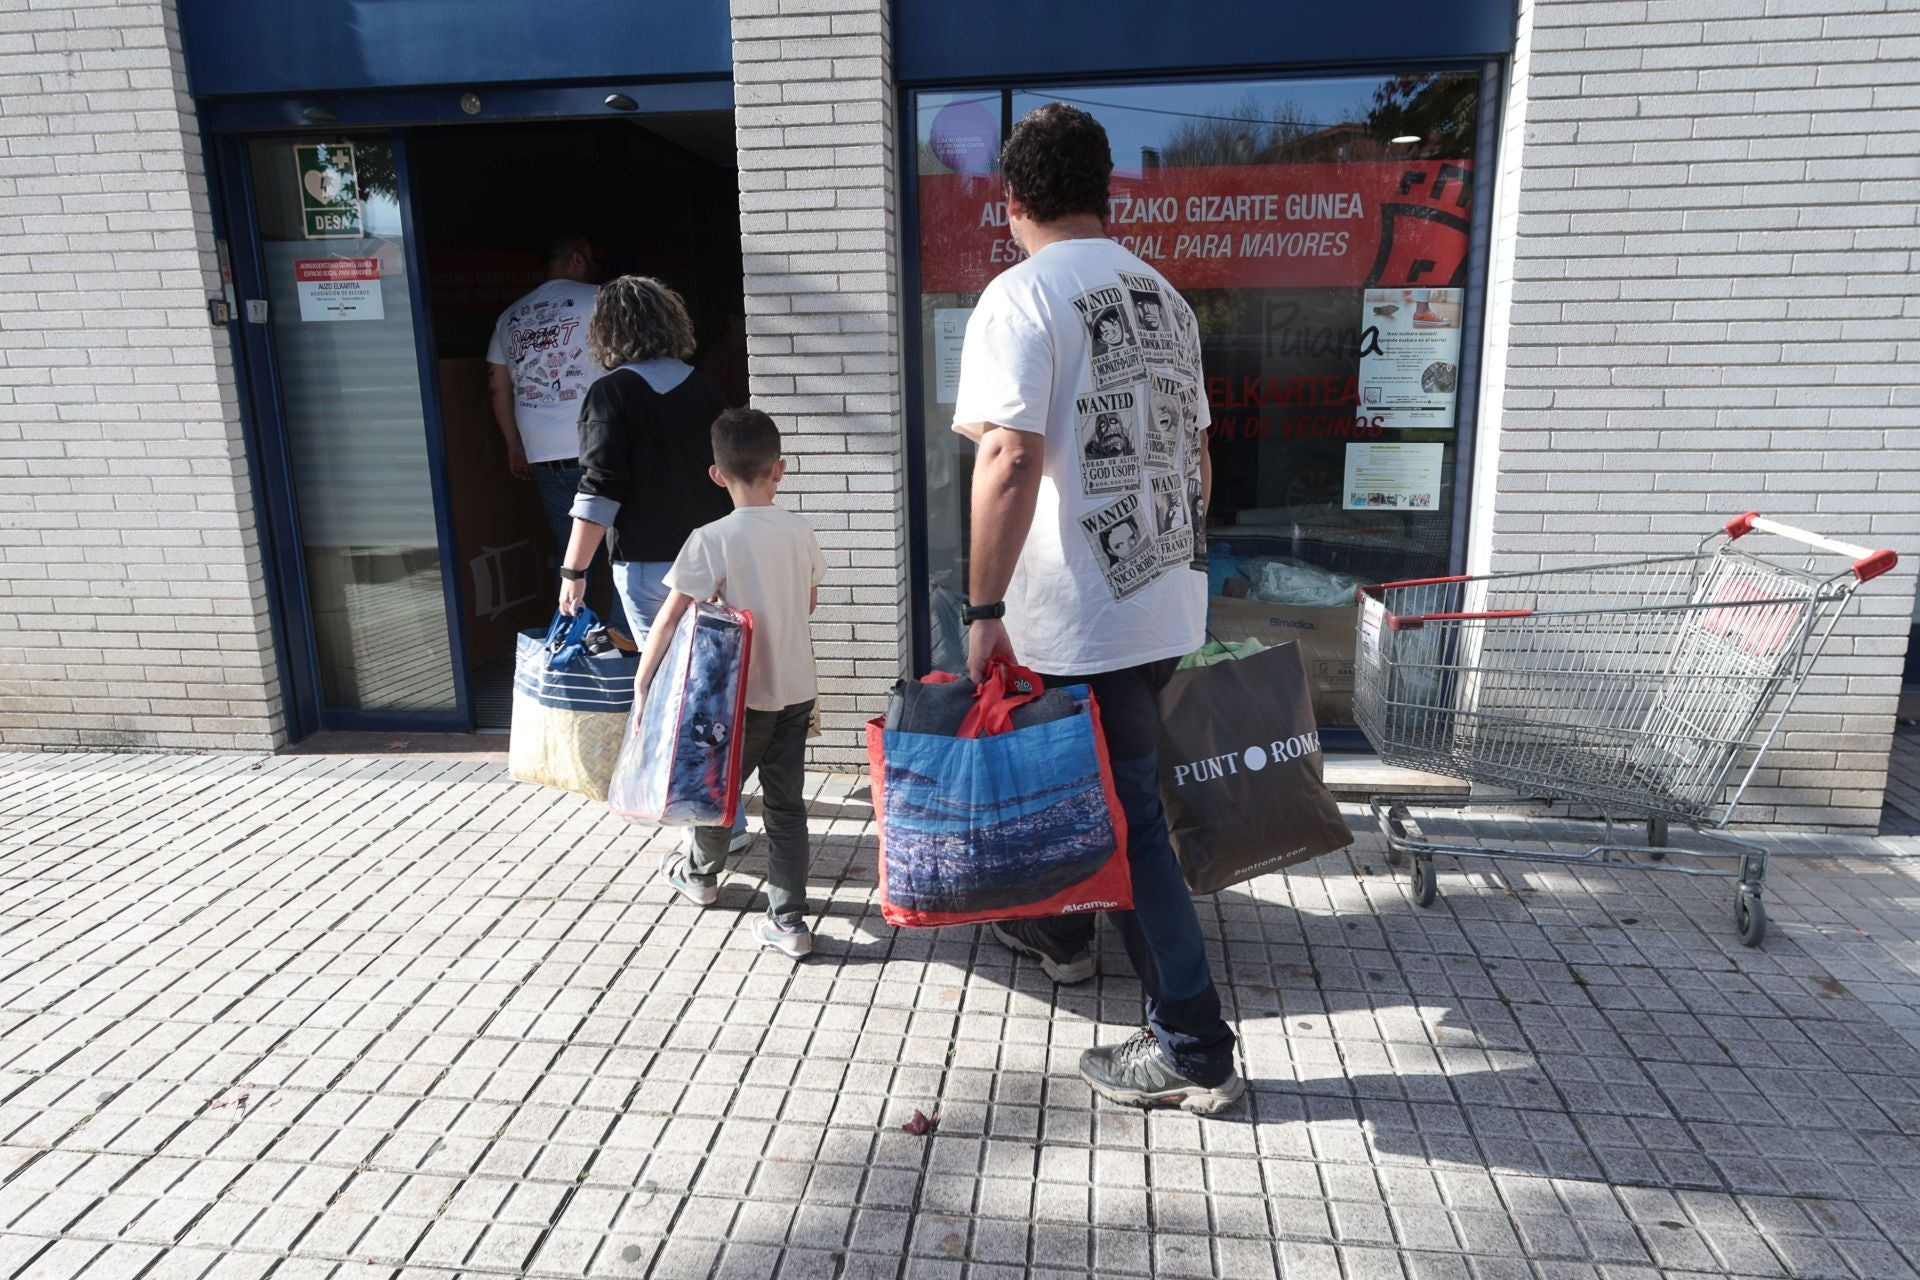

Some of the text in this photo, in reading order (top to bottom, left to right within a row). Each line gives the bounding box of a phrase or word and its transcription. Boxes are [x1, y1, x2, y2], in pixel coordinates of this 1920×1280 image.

[1186, 194, 1279, 222] GIZARTE
[1285, 192, 1364, 220] GUNEA
[315, 216, 351, 230] DESA
[1173, 234, 1232, 260] PARA
[1238, 232, 1350, 258] MAYORES
[1118, 273, 1160, 292] WANTED
[1073, 288, 1123, 314] WANTED
[1076, 392, 1134, 415] WANTED
[1208, 374, 1361, 408] ELKARTEA
[1282, 416, 1384, 439] VECINOS
[1086, 460, 1104, 468] DEAD
[1120, 456, 1136, 464] ALIVE
[1090, 464, 1136, 480] GOD USOPP
[1082, 494, 1138, 534] WANTED
[1160, 538, 1188, 554] FRANKY
[1113, 568, 1136, 586] NICO
[1135, 555, 1157, 574] ROBIN
[1173, 752, 1238, 786] PUNT
[1234, 846, 1307, 876] puntroma.com
